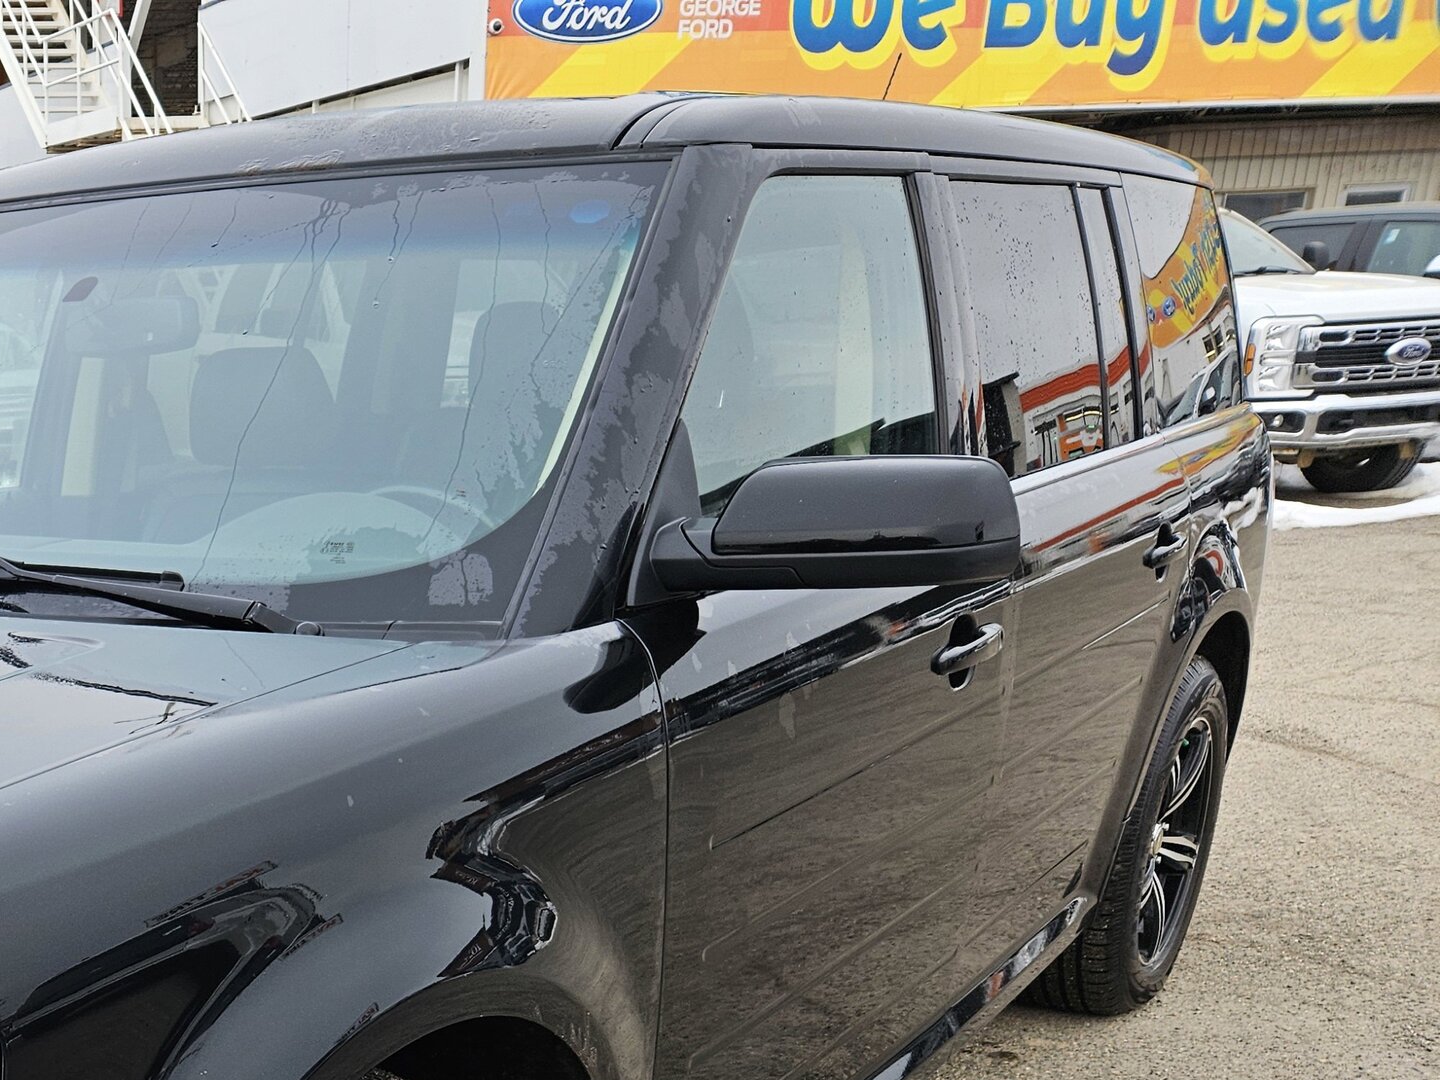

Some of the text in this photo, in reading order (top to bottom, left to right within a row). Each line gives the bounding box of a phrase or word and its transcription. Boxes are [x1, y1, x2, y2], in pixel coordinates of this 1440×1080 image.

[541, 0, 631, 31] Ford
[679, 0, 762, 17] GEORGE
[677, 19, 735, 40] FORD
